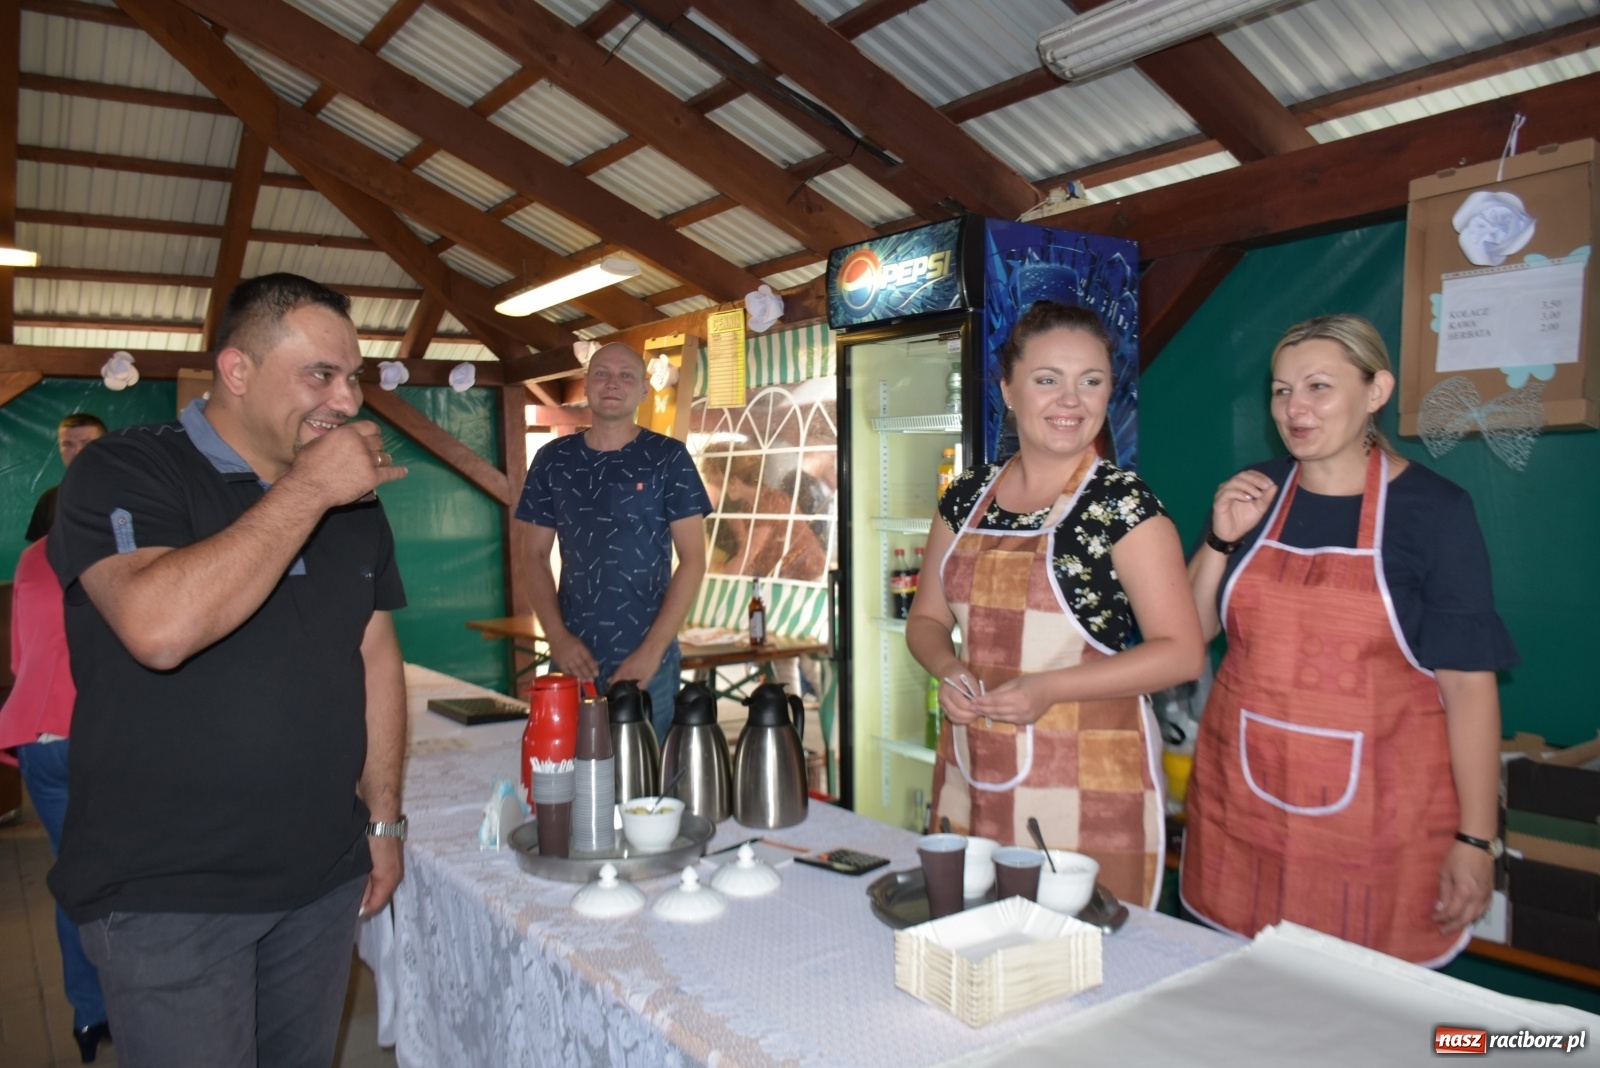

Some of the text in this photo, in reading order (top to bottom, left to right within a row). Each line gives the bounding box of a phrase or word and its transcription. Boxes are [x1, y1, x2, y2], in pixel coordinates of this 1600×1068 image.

[880, 250, 952, 290] PEPSI
[713, 314, 741, 331] CENNIK
[1448, 320, 1477, 330] KAWA
[1447, 329, 1491, 340] HERBATA
